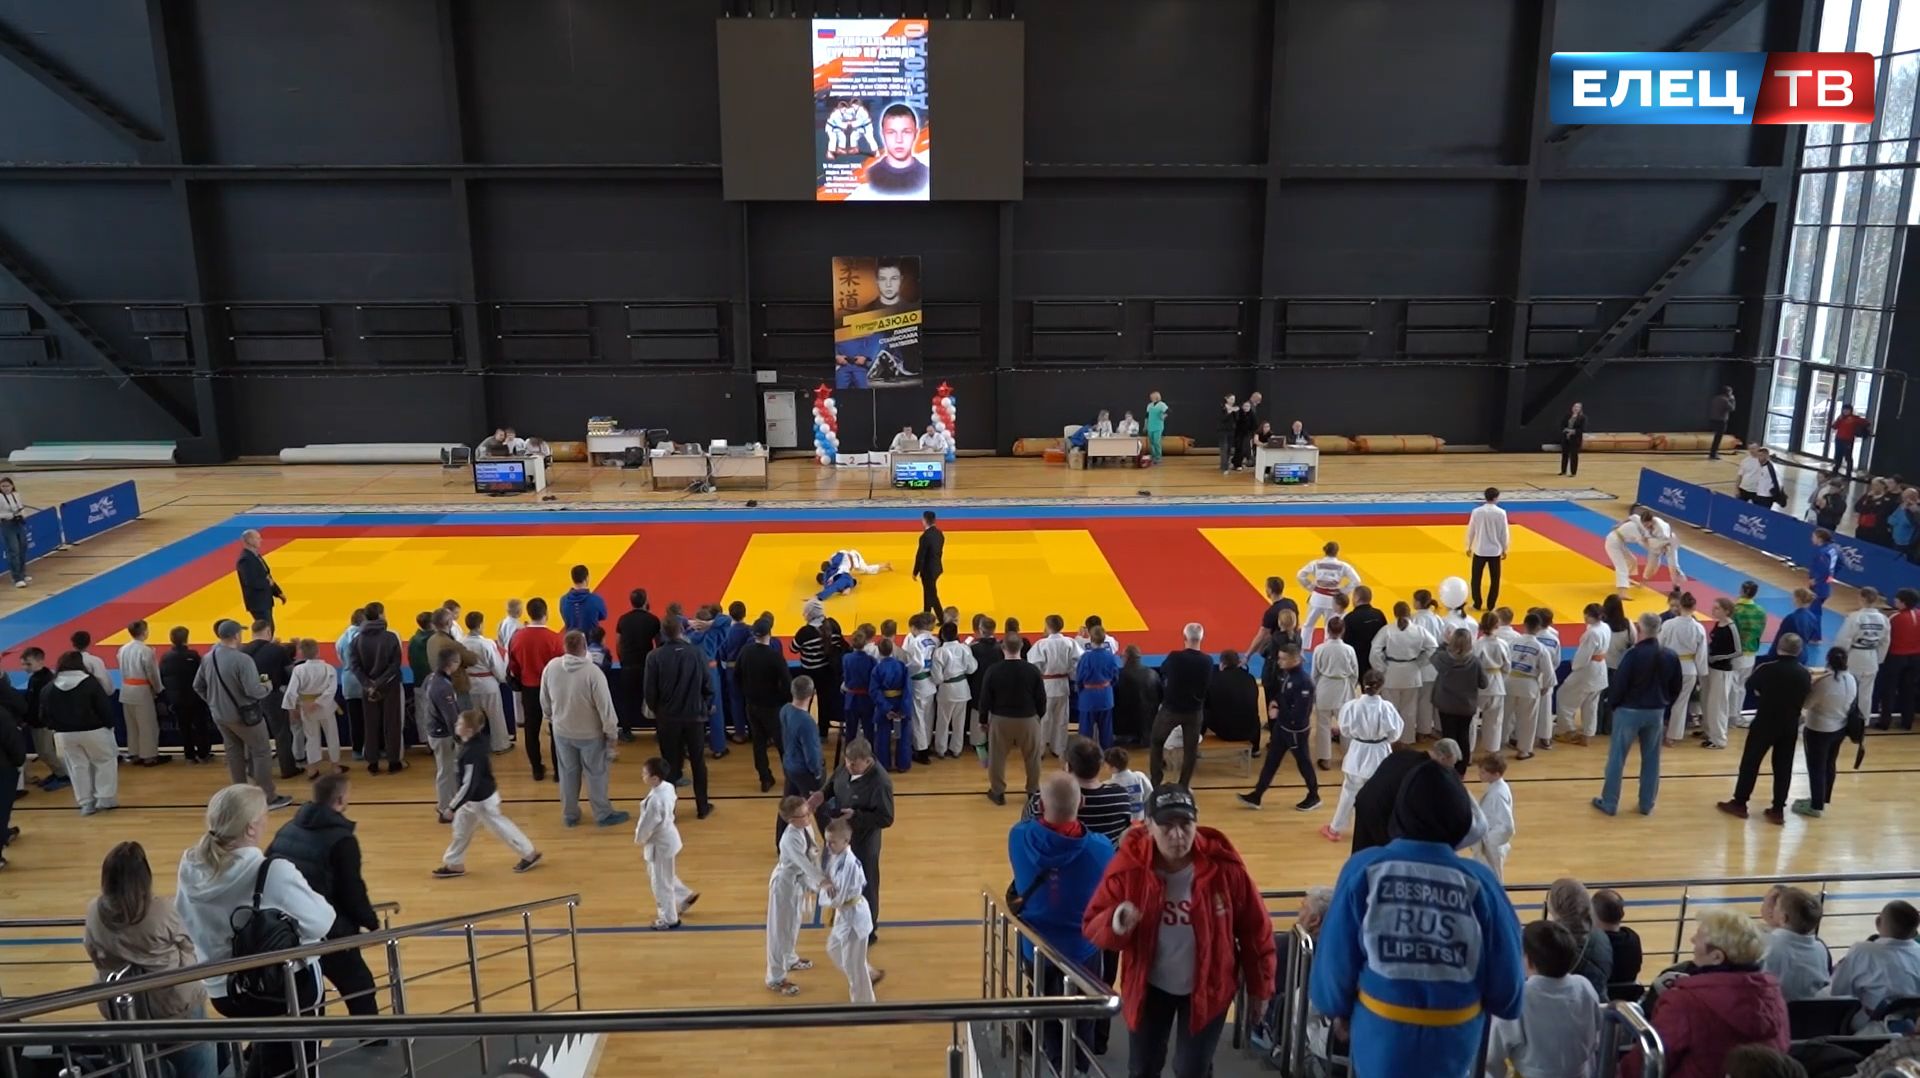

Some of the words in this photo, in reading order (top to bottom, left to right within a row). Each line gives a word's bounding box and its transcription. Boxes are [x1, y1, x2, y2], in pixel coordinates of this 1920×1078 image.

[904, 24, 929, 110] ДЗЮДО
[878, 313, 918, 329] ДЗЮДО
[1380, 880, 1469, 911] Z.BESPALOV
[1394, 908, 1457, 940] RUS
[1383, 940, 1465, 964] LIPETSK
